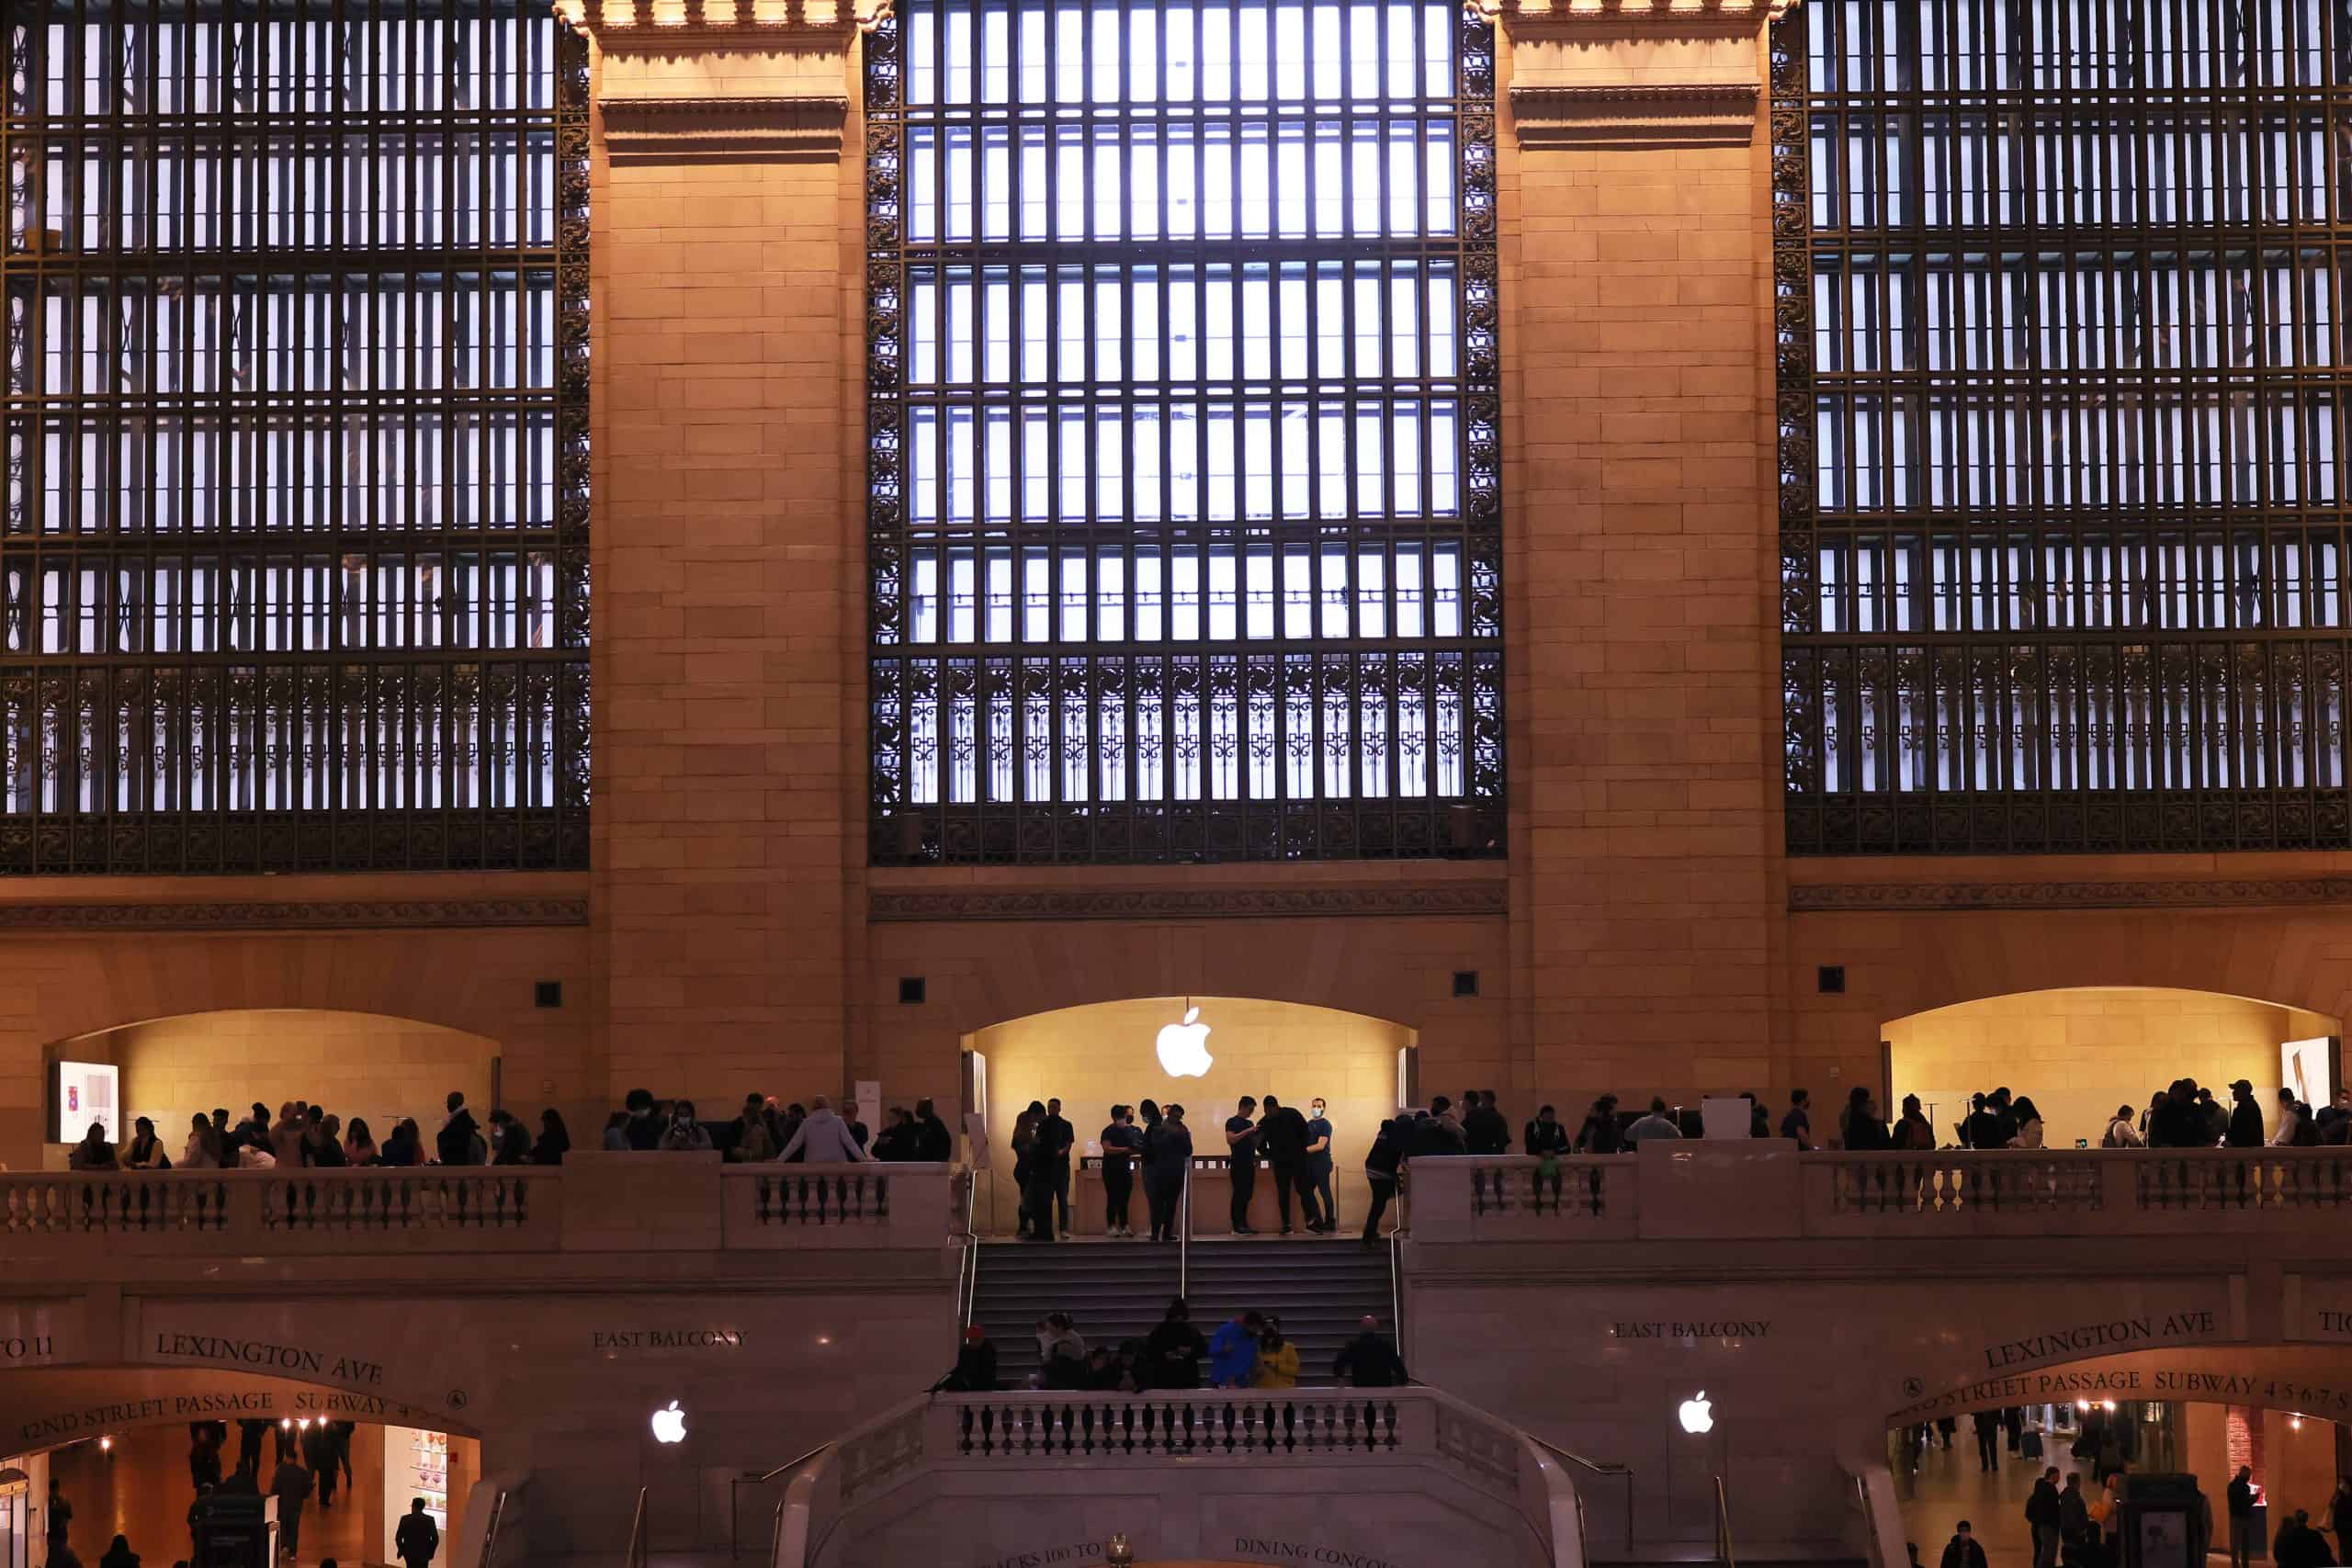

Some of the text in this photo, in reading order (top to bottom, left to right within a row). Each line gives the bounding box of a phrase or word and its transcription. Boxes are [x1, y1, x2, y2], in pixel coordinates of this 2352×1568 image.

[594, 1331, 749, 1348] EAST BALCONY
[1617, 1322, 1770, 1337] EAST BALCONY
[1985, 1312, 2215, 1369] LEXINGTON AVE
[154, 1333, 383, 1384] LEXINGTON AVE
[1942, 1376, 2030, 1405] STREET
[2039, 1371, 2142, 1393] PASSAGE
[2154, 1371, 2257, 1395] SUBWAY
[83, 1397, 167, 1427] STREET
[175, 1392, 273, 1416] PASSAGE
[294, 1391, 387, 1416] SUBWAY
[1074, 1541, 1101, 1559] TO
[1235, 1537, 1308, 1559] DINING
